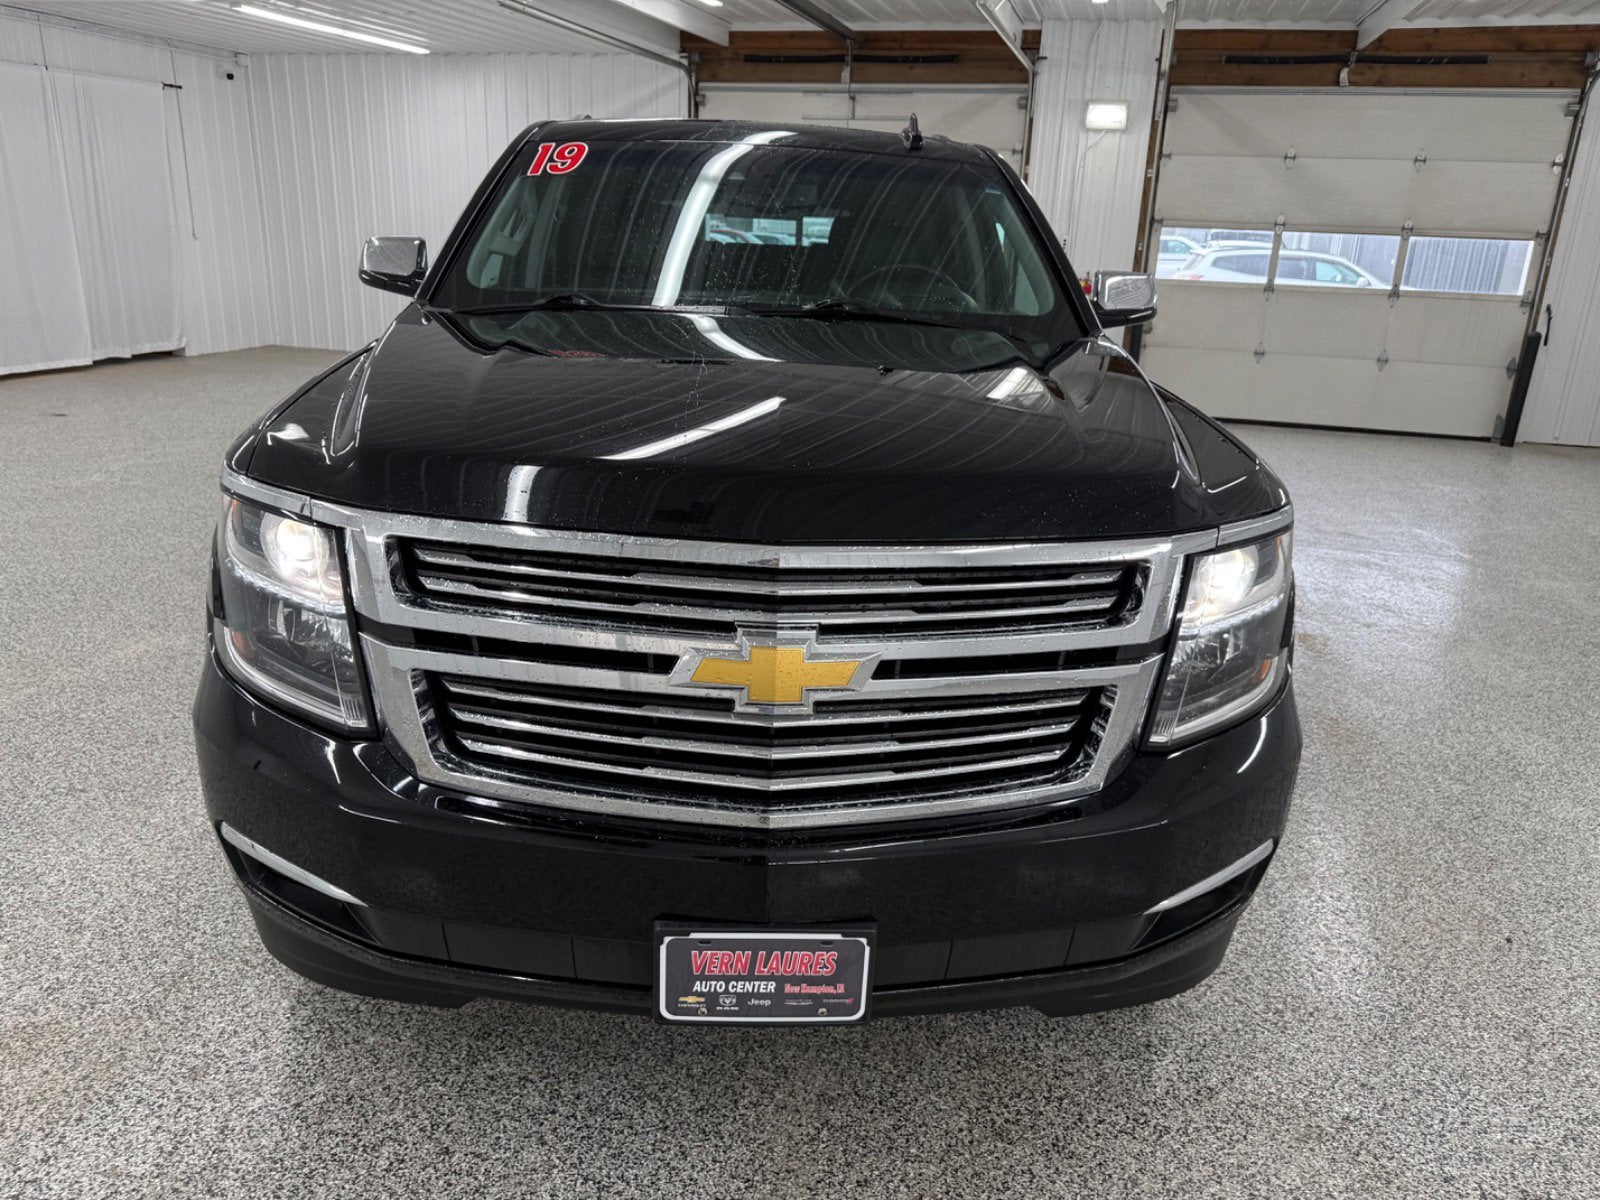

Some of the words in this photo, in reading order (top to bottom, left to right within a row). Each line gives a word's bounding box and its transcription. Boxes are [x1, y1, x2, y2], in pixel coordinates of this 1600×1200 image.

[527, 142, 588, 176] 19
[690, 950, 751, 975] VERN
[754, 950, 838, 976] LAURES
[692, 981, 729, 993] AUTO
[730, 981, 776, 993] CENTER
[784, 983, 800, 993] New
[747, 998, 771, 1007] Jeep
